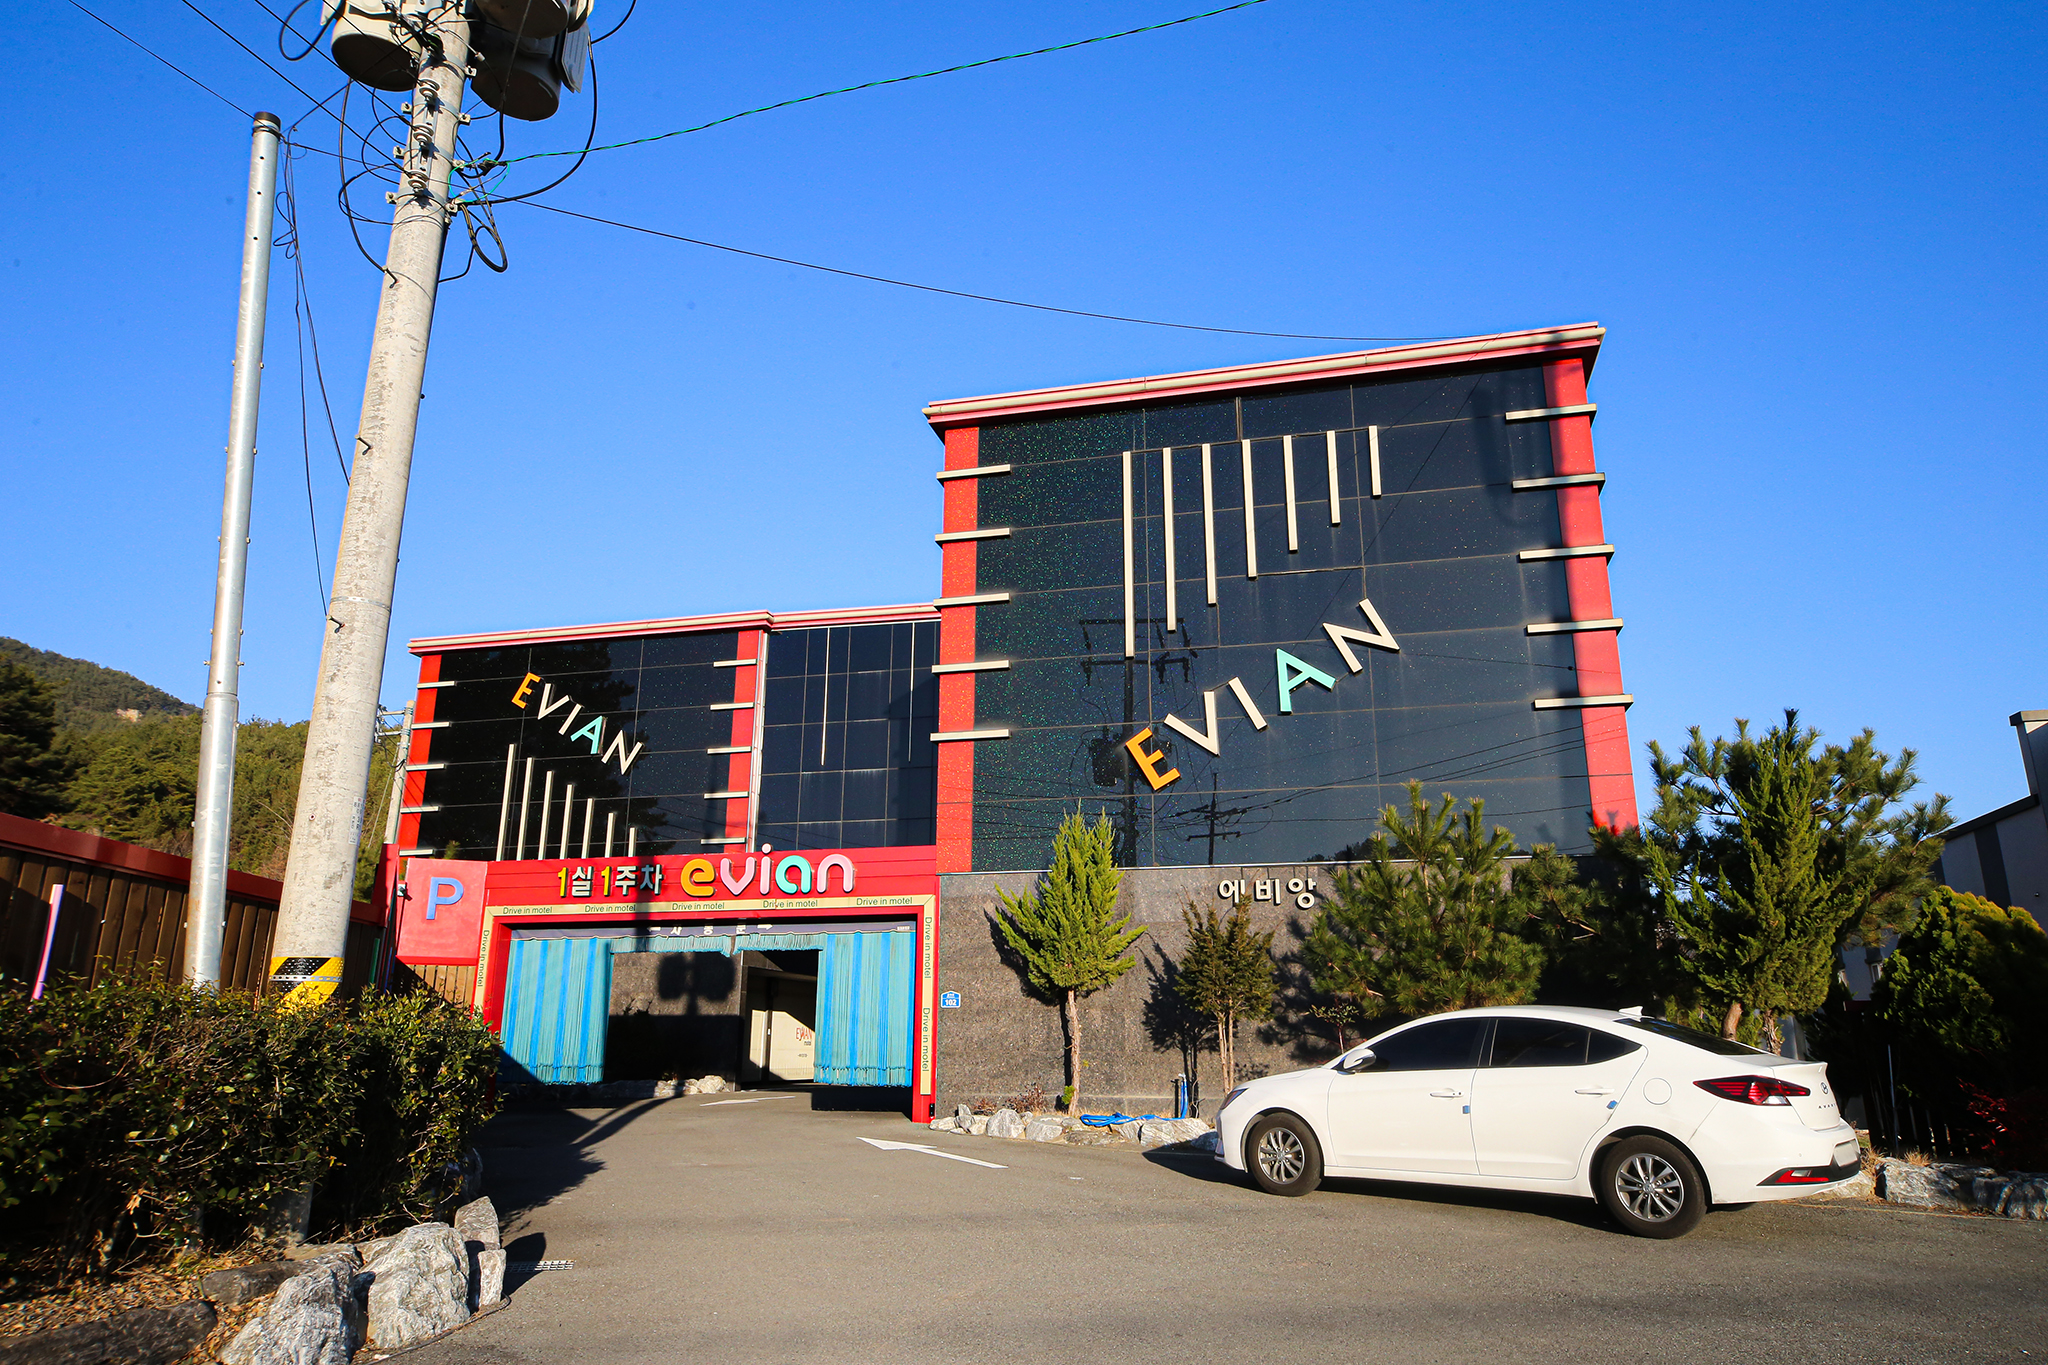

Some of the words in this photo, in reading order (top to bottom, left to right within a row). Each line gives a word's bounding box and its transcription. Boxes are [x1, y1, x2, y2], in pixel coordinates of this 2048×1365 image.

[1125, 598, 1400, 791] EVIAN
[511, 672, 643, 776] EVIAN
[558, 865, 594, 897] 1실
[601, 864, 664, 896] 1주차
[680, 843, 855, 896] evian
[426, 876, 464, 920] P
[763, 900, 784, 908] Drive
[785, 900, 792, 908] in
[793, 899, 818, 907] motel
[856, 898, 877, 906] Drive
[888, 897, 913, 905] motel
[1219, 877, 1317, 909] 에비앙
[503, 907, 522, 915] Drive
[531, 906, 552, 914] motel
[585, 905, 605, 913] Drive
[613, 904, 636, 912] motel
[672, 902, 693, 910] Drive
[694, 902, 701, 910] in
[702, 902, 725, 910] motel
[480, 930, 490, 952] Drive
[925, 943, 932, 951] in
[480, 953, 487, 962] in
[477, 963, 485, 987] motel
[922, 1007, 930, 1032] Drive
[923, 1034, 930, 1043] in
